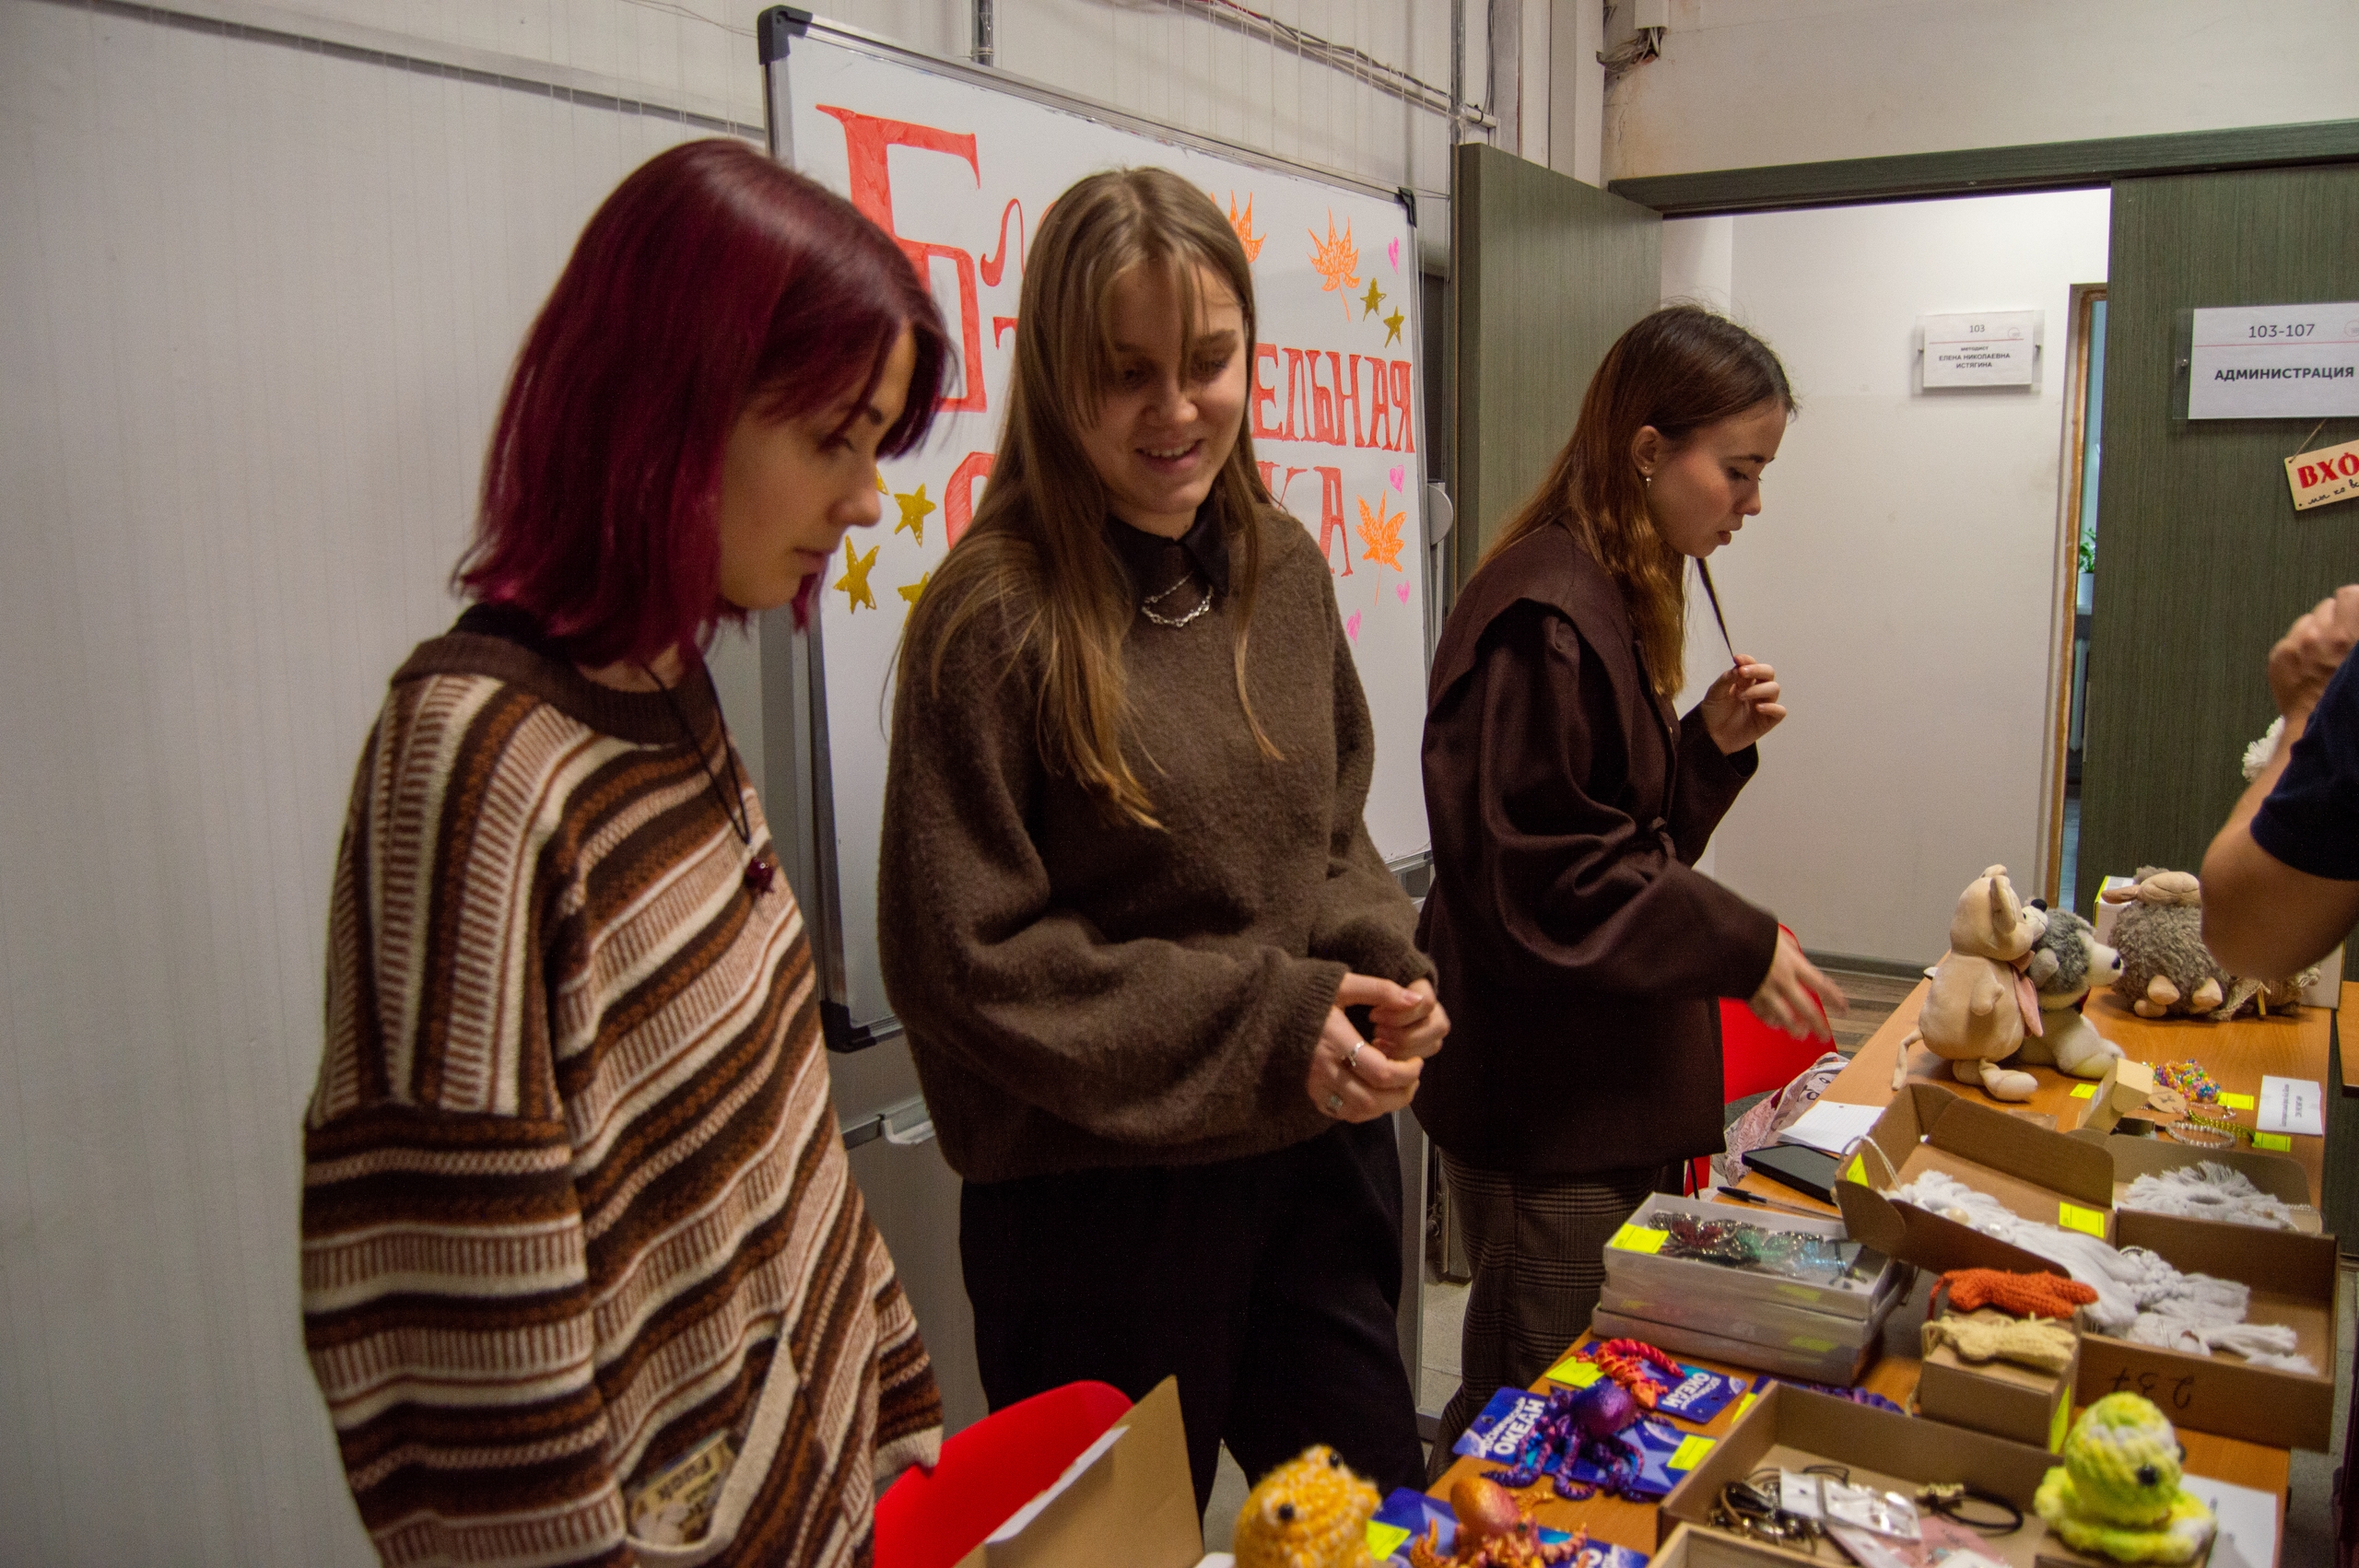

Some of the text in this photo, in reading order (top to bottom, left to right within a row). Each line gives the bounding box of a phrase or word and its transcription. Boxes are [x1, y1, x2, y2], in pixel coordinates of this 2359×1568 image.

[1969, 324, 1986, 333] 103
[2248, 323, 2316, 338] 103-107
[2214, 367, 2355, 382] АДМИНИСТРАЦИЯ
[1661, 1372, 1711, 1409] ОКЕАН
[1493, 1398, 1546, 1456] ОКЕАН
